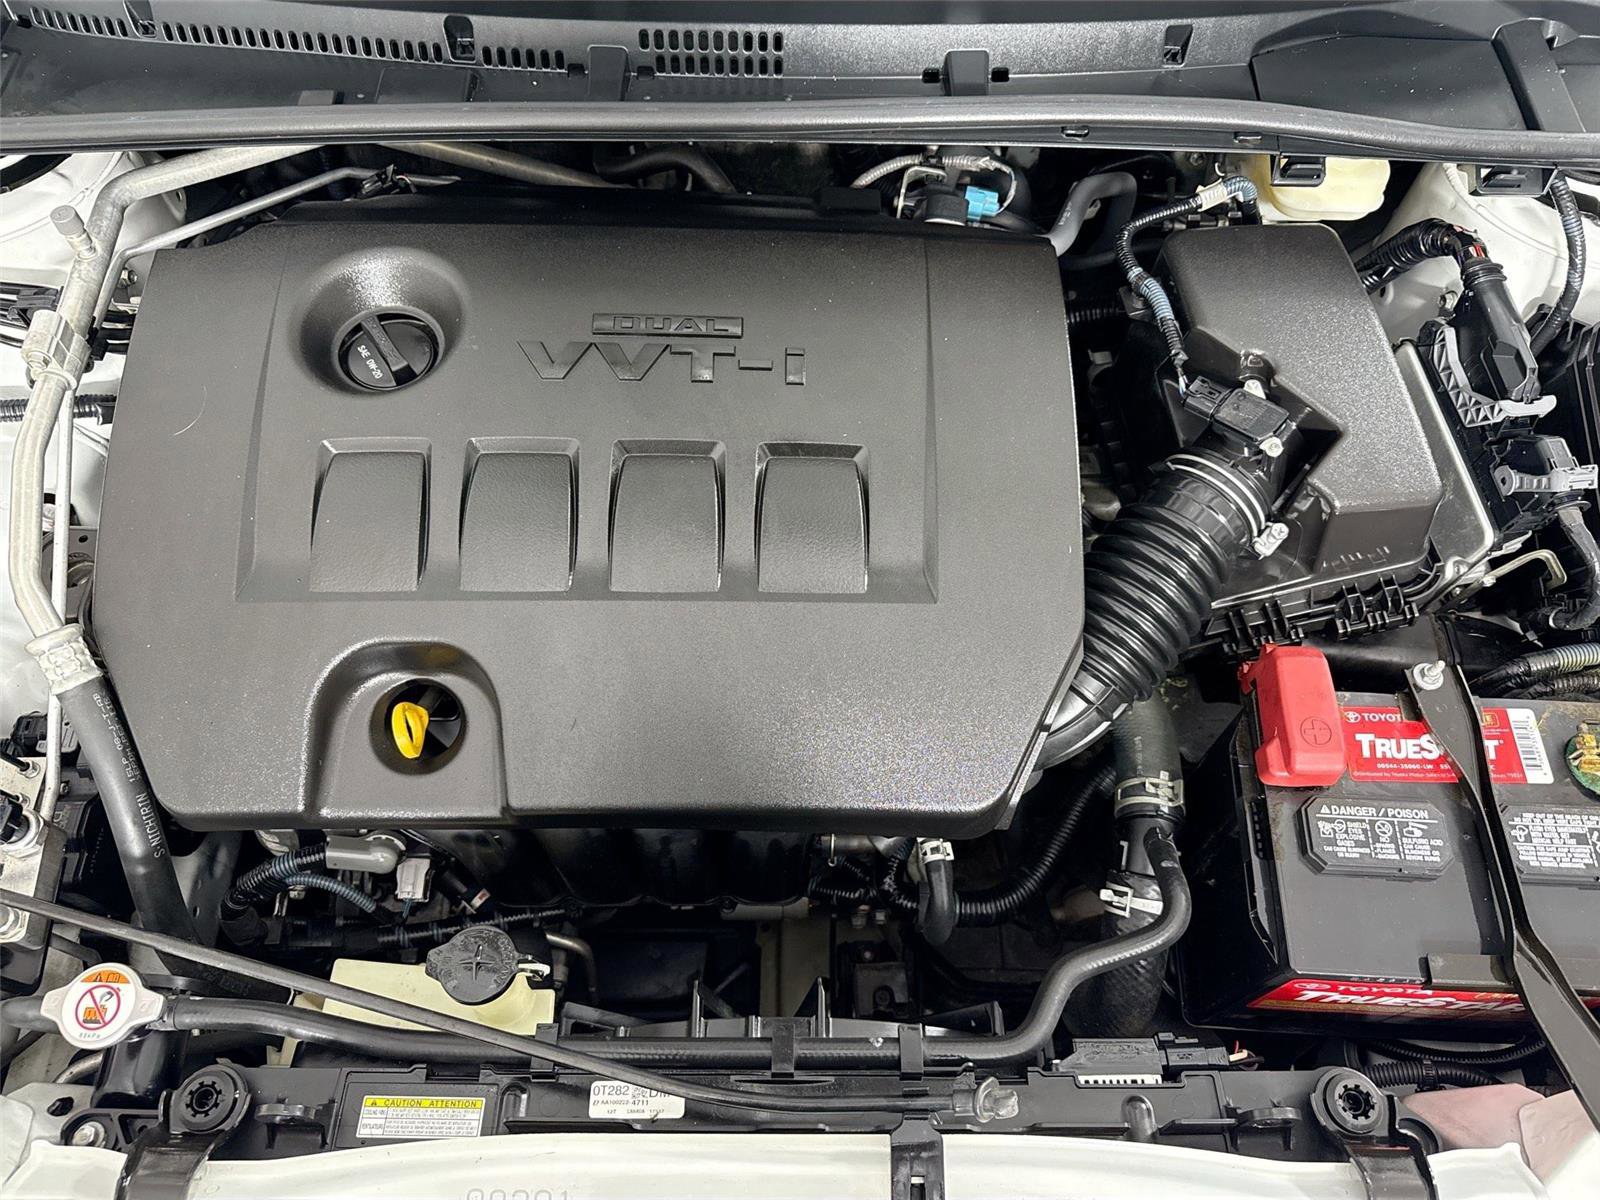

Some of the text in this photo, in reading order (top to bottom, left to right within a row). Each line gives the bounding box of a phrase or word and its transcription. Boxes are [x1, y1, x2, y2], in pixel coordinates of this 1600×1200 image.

[613, 316, 729, 332] DUAL
[357, 344, 383, 379] SAE 0W-20
[517, 341, 805, 385] VVT-i
[1362, 712, 1403, 723] TOYOT
[1355, 733, 1500, 760] TRUEST
[1331, 805, 1377, 817] DANGER
[1387, 807, 1429, 819] POISON
[1337, 985, 1433, 996] TOYOTA
[1294, 989, 1526, 1012] TRUESTAR
[592, 1085, 630, 1097] 0T282
[383, 1099, 477, 1108] CAUTION ATTENTION
